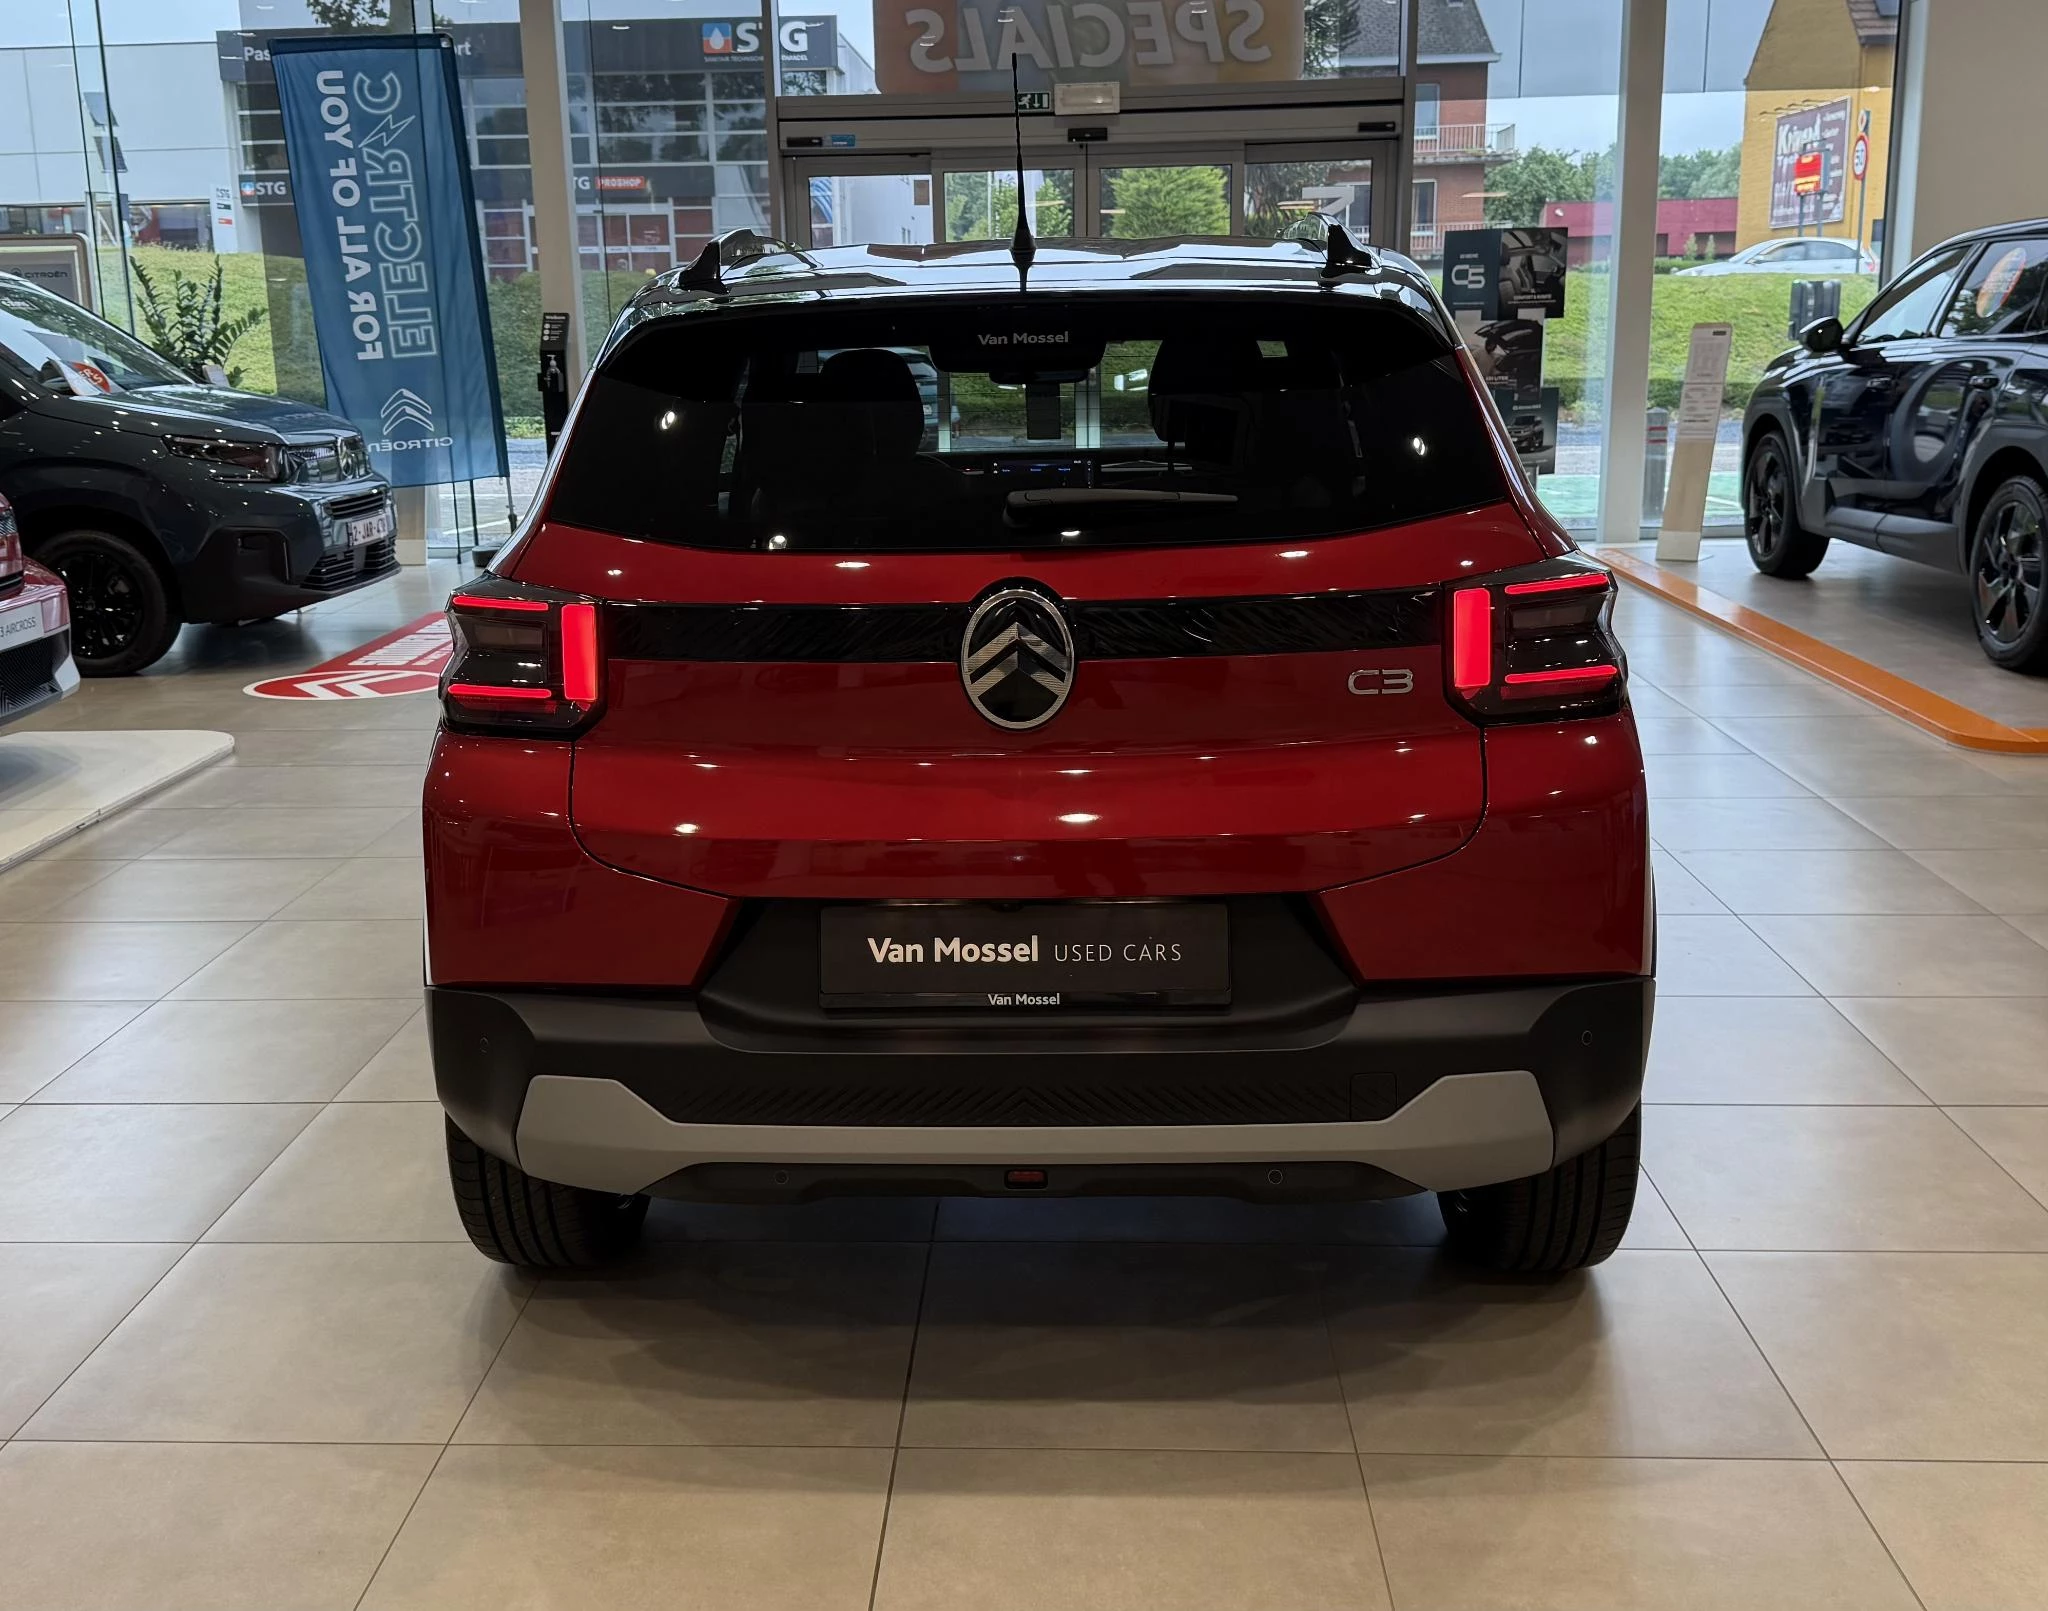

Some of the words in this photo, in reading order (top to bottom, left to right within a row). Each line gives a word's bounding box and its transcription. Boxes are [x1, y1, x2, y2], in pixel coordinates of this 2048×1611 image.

[736, 20, 808, 53] SG
[256, 181, 287, 196] STG
[1451, 264, 1486, 289] C5
[977, 333, 1008, 345] Van
[1013, 330, 1069, 344] Mossel
[5, 616, 37, 636] AIRCROSS
[1348, 668, 1414, 695] C3
[867, 937, 924, 963] Van
[934, 935, 1039, 963] Mossel
[1054, 943, 1112, 962] USED
[1123, 943, 1182, 962] CARS
[988, 994, 1012, 1006] Van
[1015, 993, 1061, 1006] Mossel
